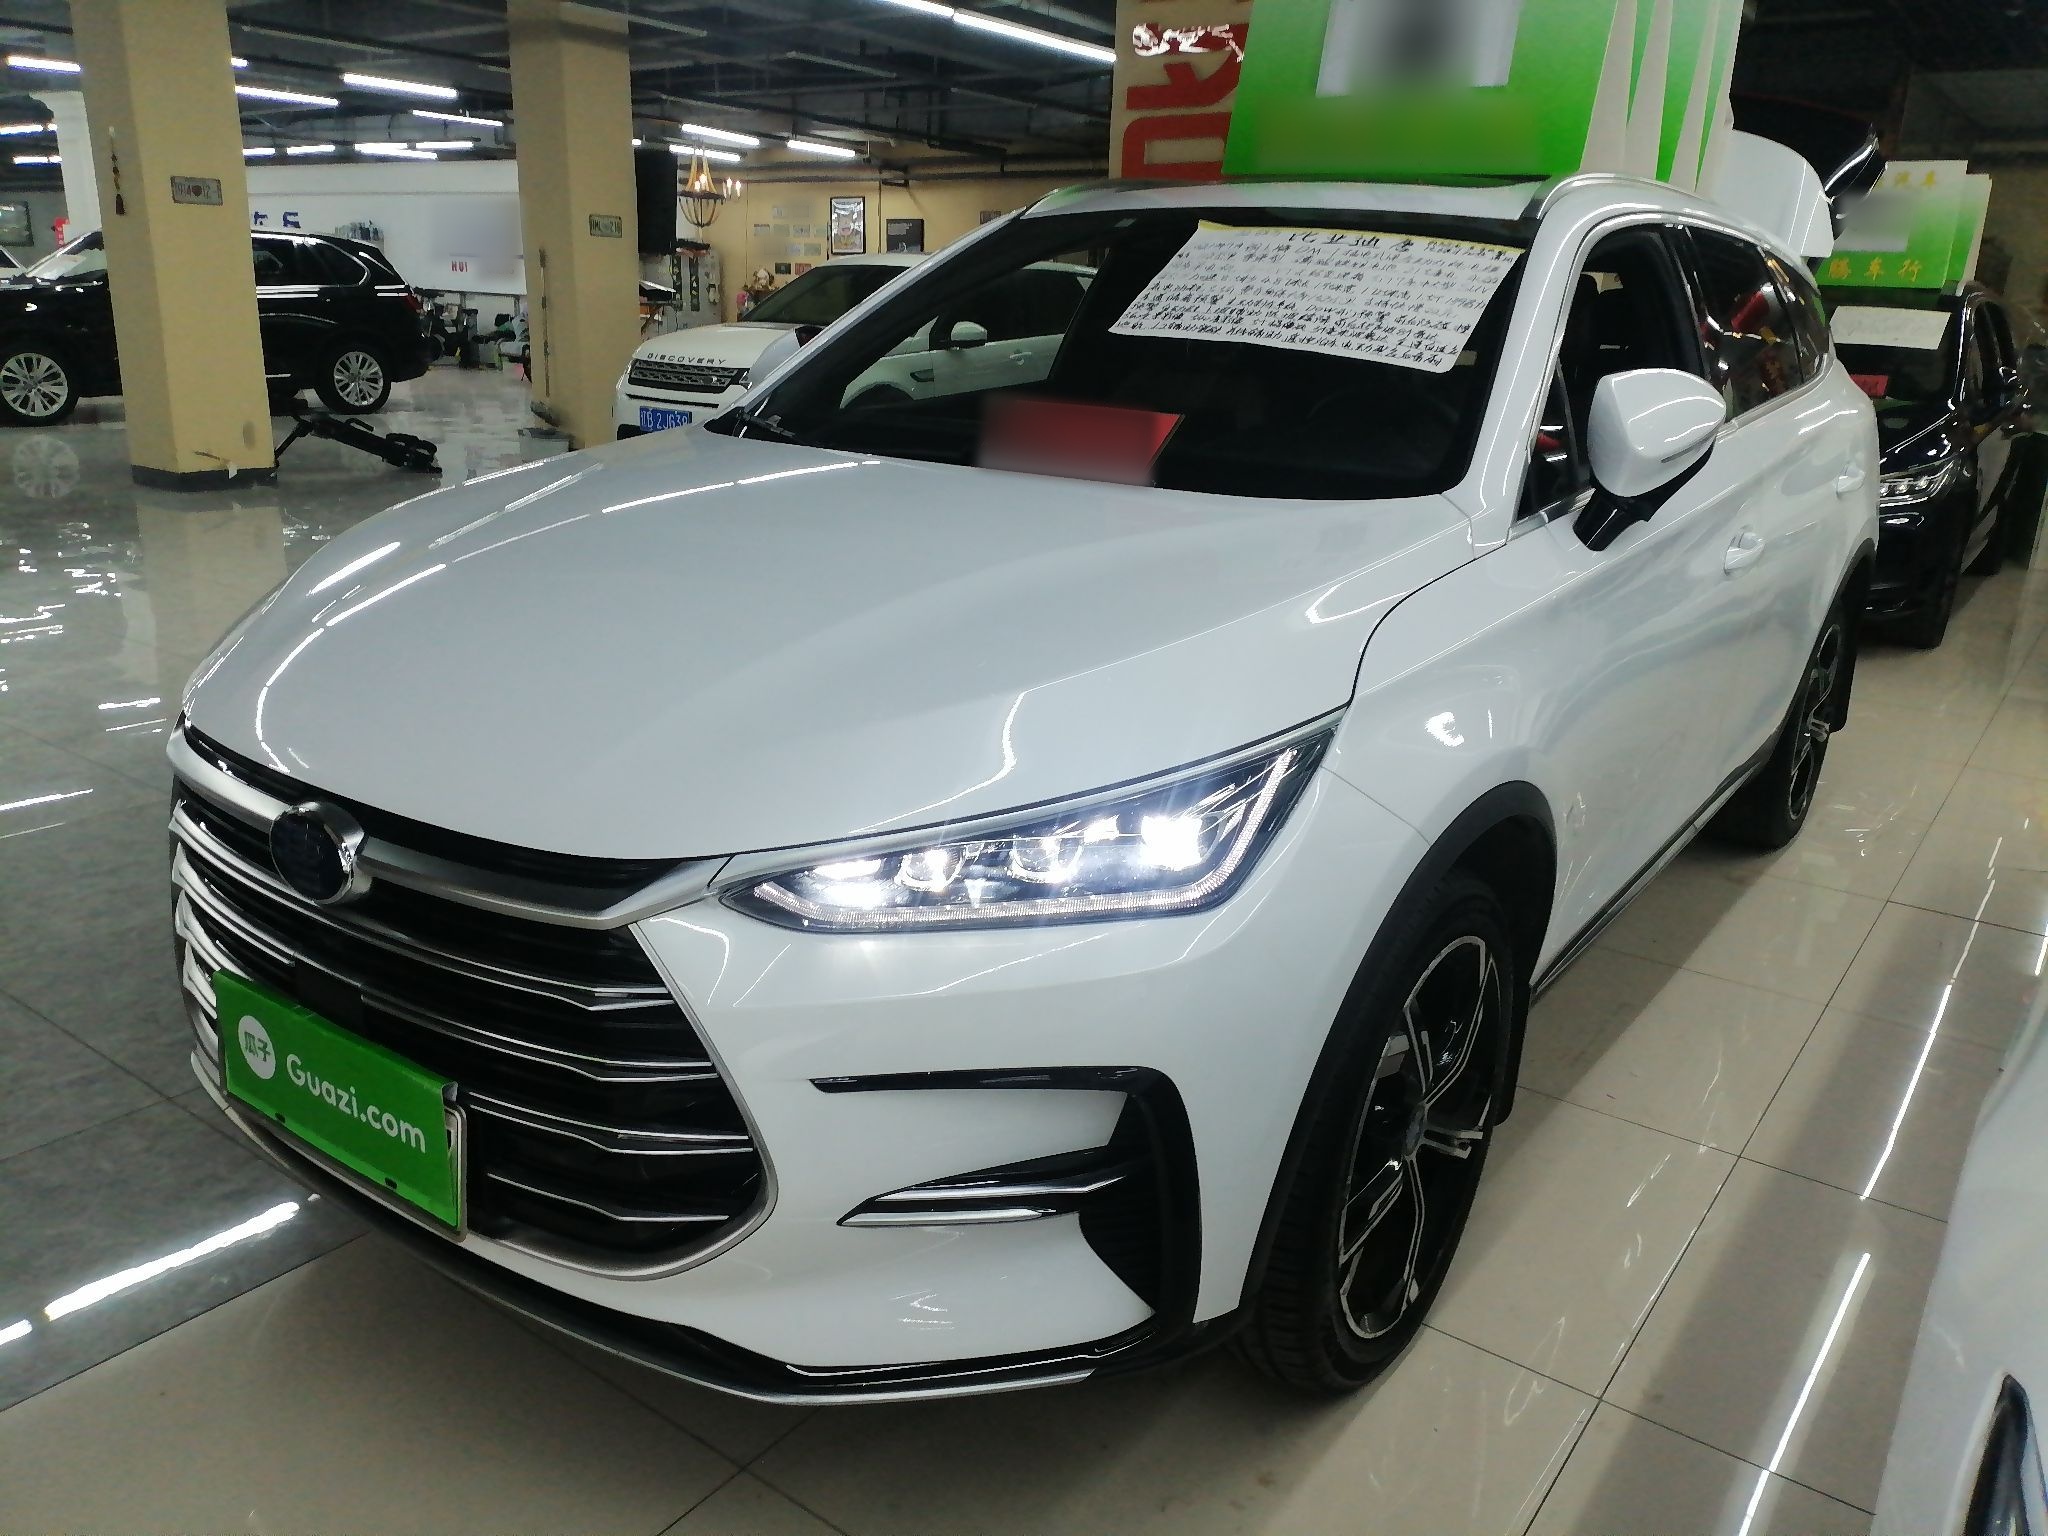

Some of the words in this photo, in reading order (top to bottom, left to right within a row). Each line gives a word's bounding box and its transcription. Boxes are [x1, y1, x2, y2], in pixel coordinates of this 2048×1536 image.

[647, 352, 726, 365] DISCOVERY
[243, 1031, 271, 1062] 瓜子
[286, 1053, 426, 1154] Guazi.com
